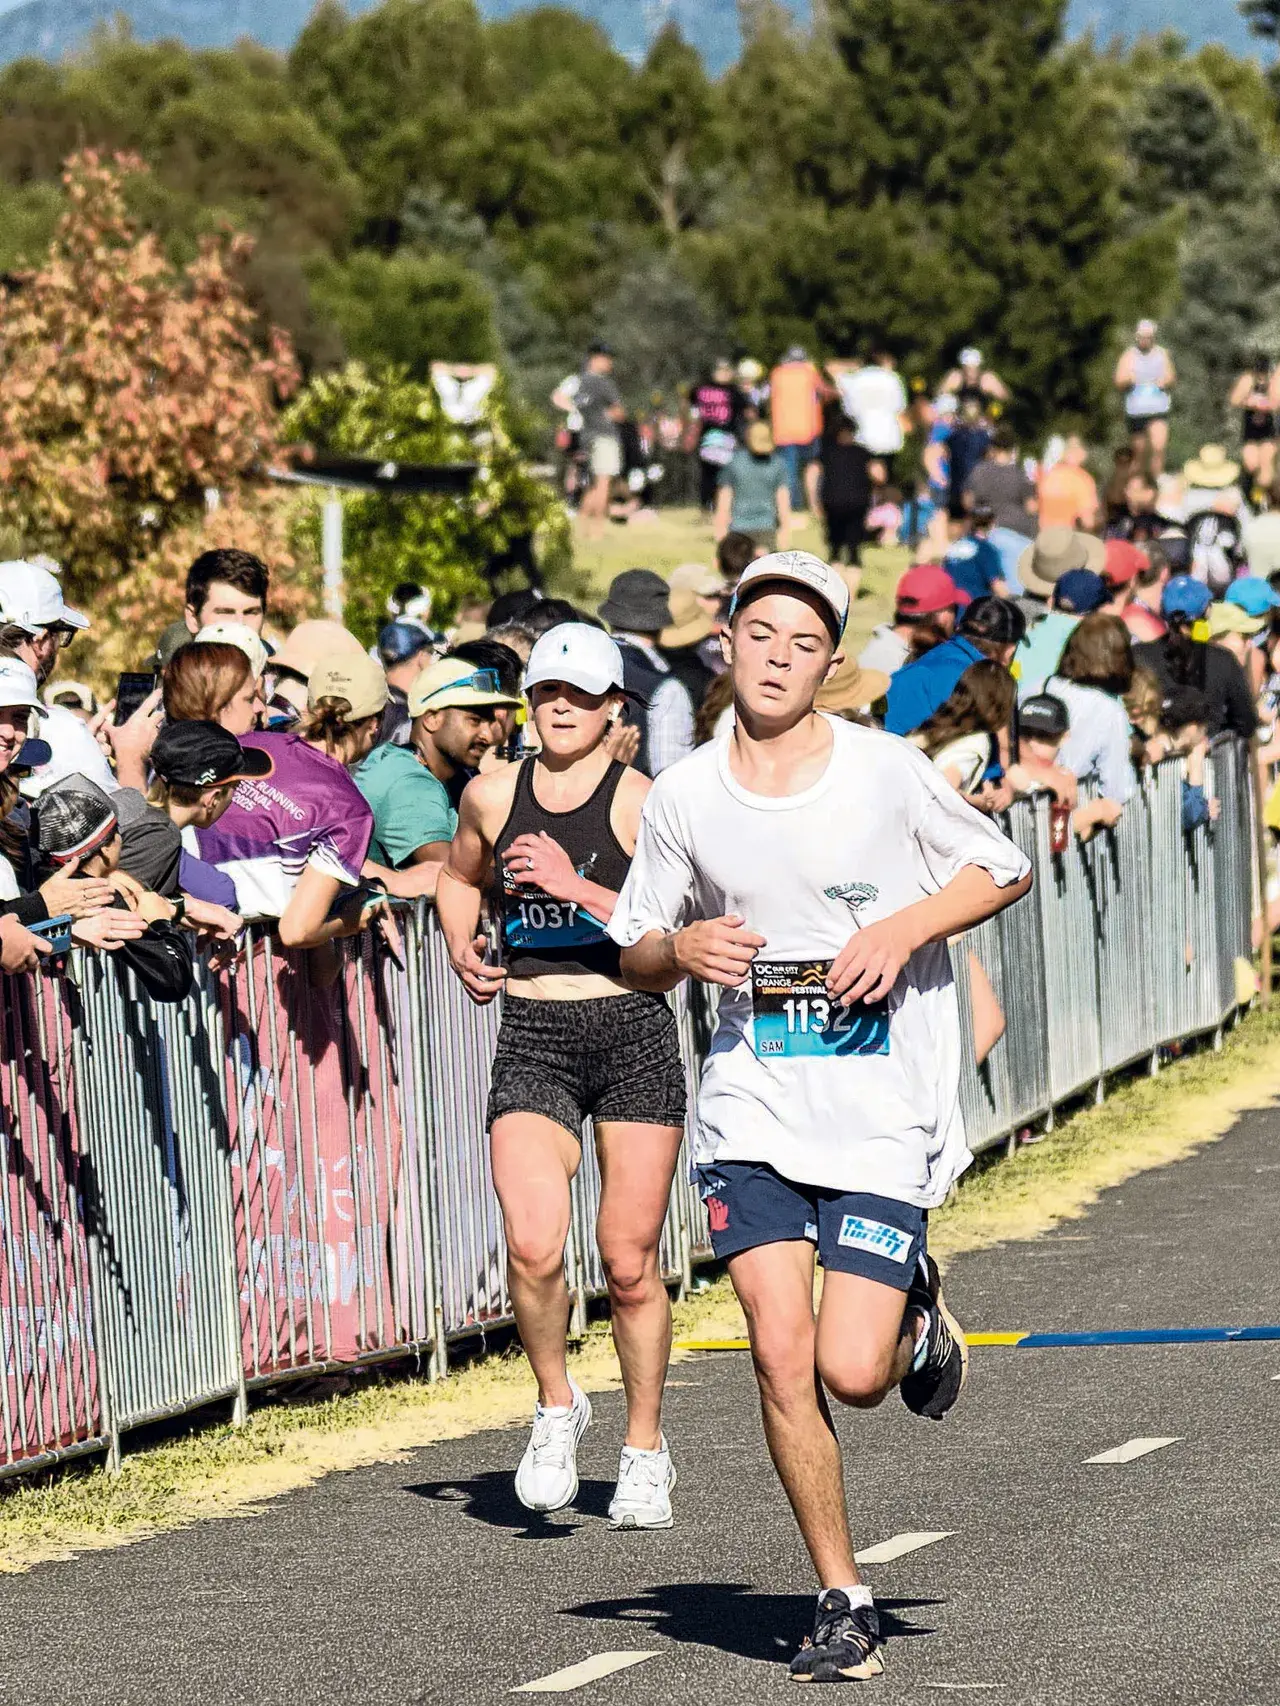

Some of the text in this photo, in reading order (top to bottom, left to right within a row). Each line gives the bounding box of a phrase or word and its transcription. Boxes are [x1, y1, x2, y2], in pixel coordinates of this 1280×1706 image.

[236, 780, 272, 811] ESTIVAL
[256, 781, 306, 821] RUNNING
[518, 903, 577, 930] 1037
[755, 978, 792, 987] ORANGE
[791, 986, 828, 995] FESTIVAL
[783, 999, 852, 1034] 1132
[761, 1041, 784, 1052] SAM
